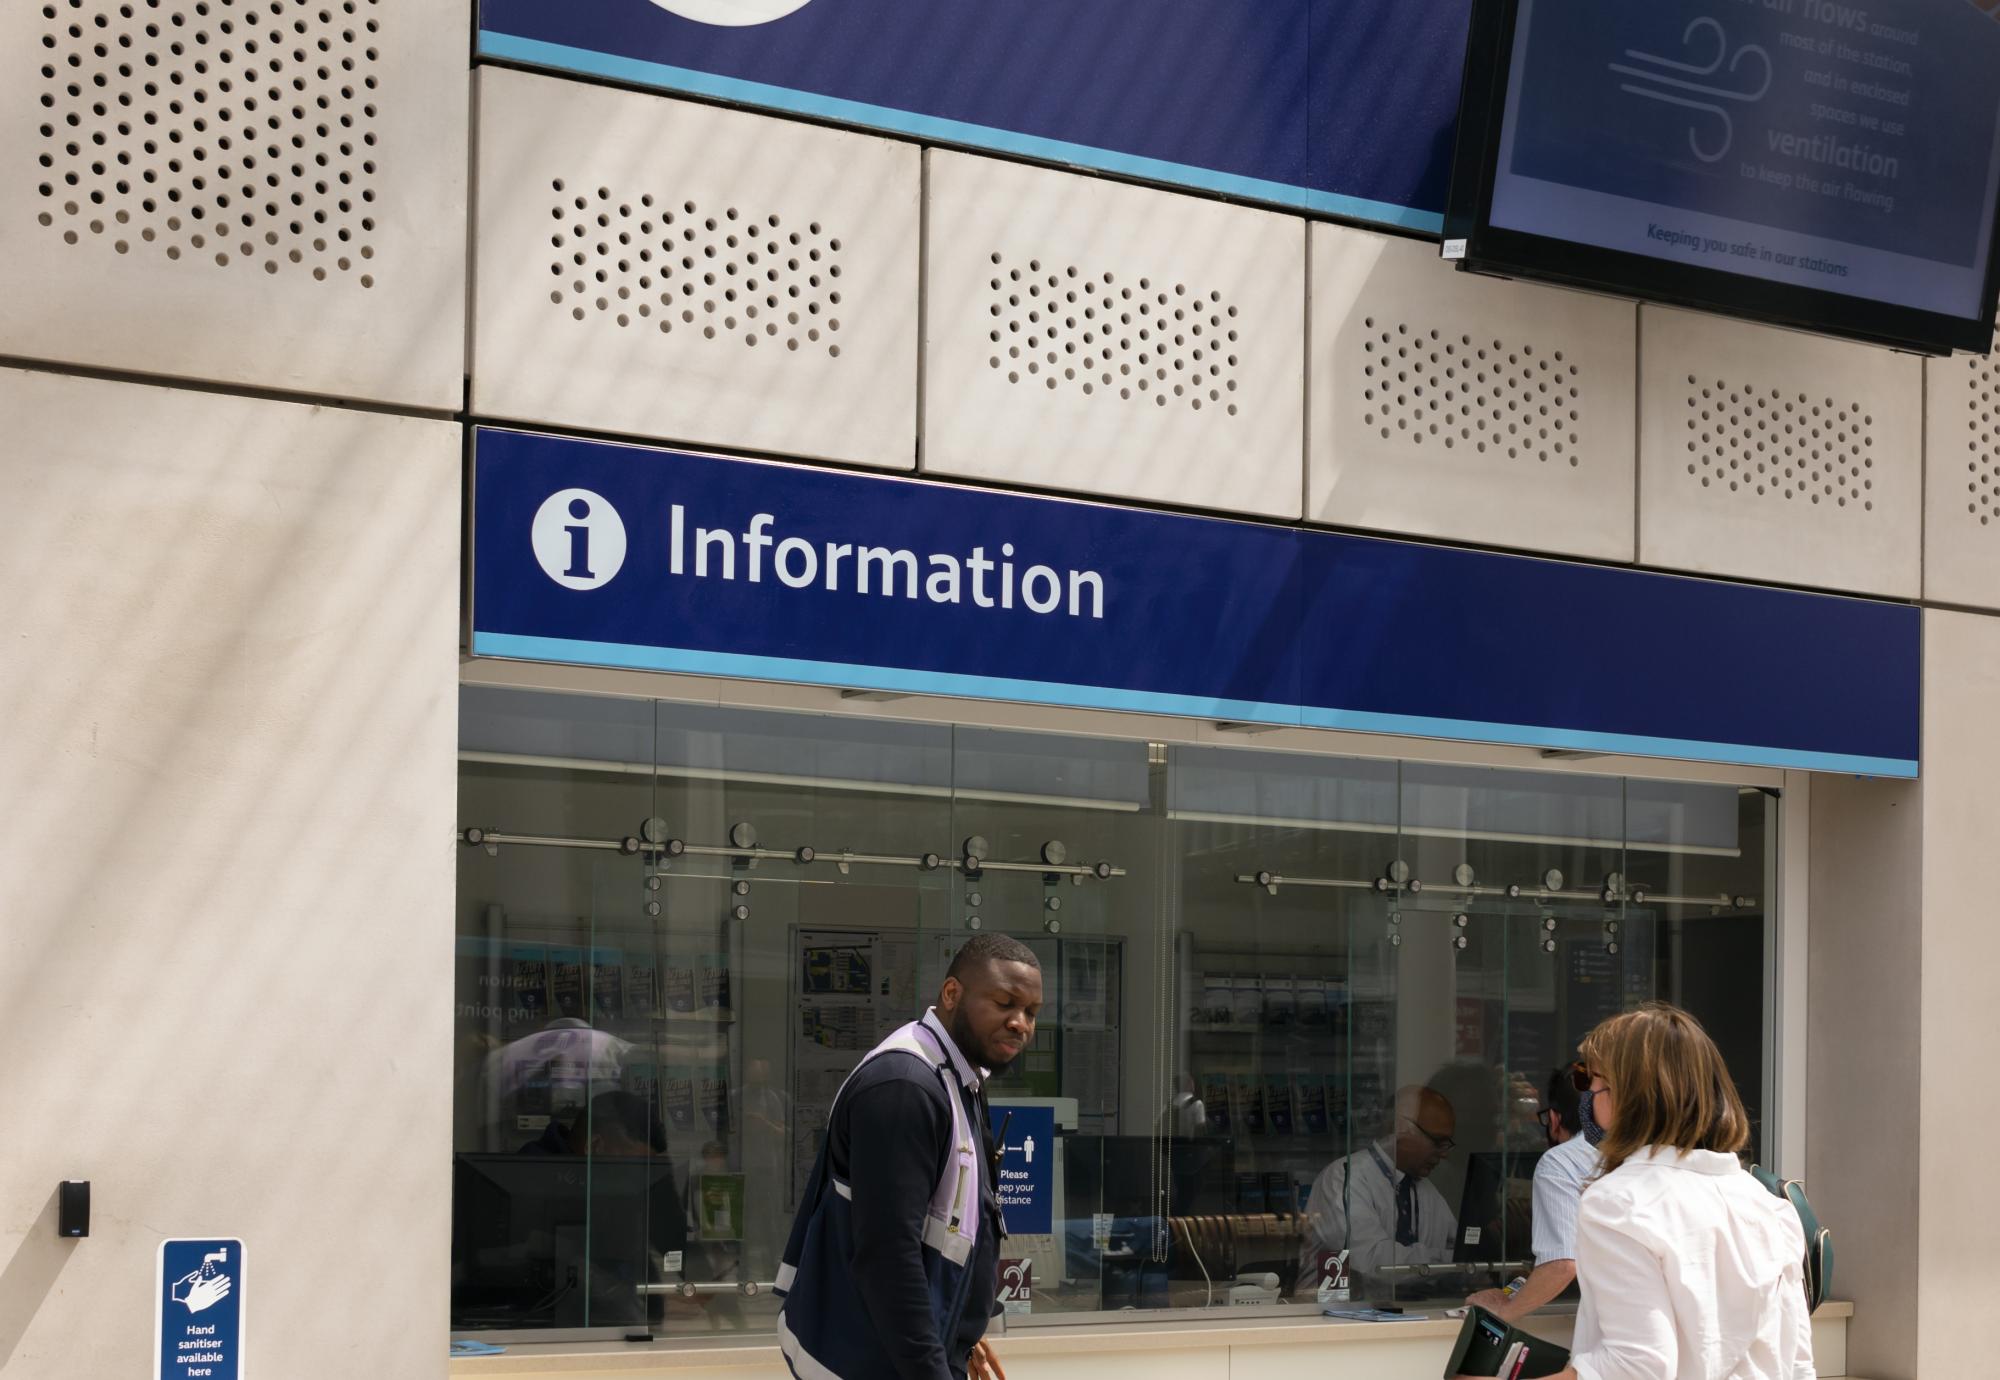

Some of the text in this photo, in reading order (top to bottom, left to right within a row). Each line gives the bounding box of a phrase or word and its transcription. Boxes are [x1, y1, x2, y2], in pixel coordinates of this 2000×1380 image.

[1779, 31, 1816, 50] most
[1818, 39, 1836, 55] of
[1837, 44, 1860, 63] the
[1870, 23, 1919, 46] around
[1804, 69, 1911, 106] and in enclosed
[1809, 103, 1904, 136] spaces we use
[1767, 129, 1898, 179] ventilation
[1740, 162, 1894, 213] to keep the air flowing
[1647, 223, 1849, 277] Keeping you safe in our stations
[670, 504, 1105, 618] Information
[1000, 1169, 1028, 1179] Please
[998, 1184, 1034, 1193] eep your
[186, 1325, 215, 1335] Hand
[178, 1339, 222, 1349] sanitiser
[177, 1353, 223, 1363] available
[188, 1367, 212, 1377] here
